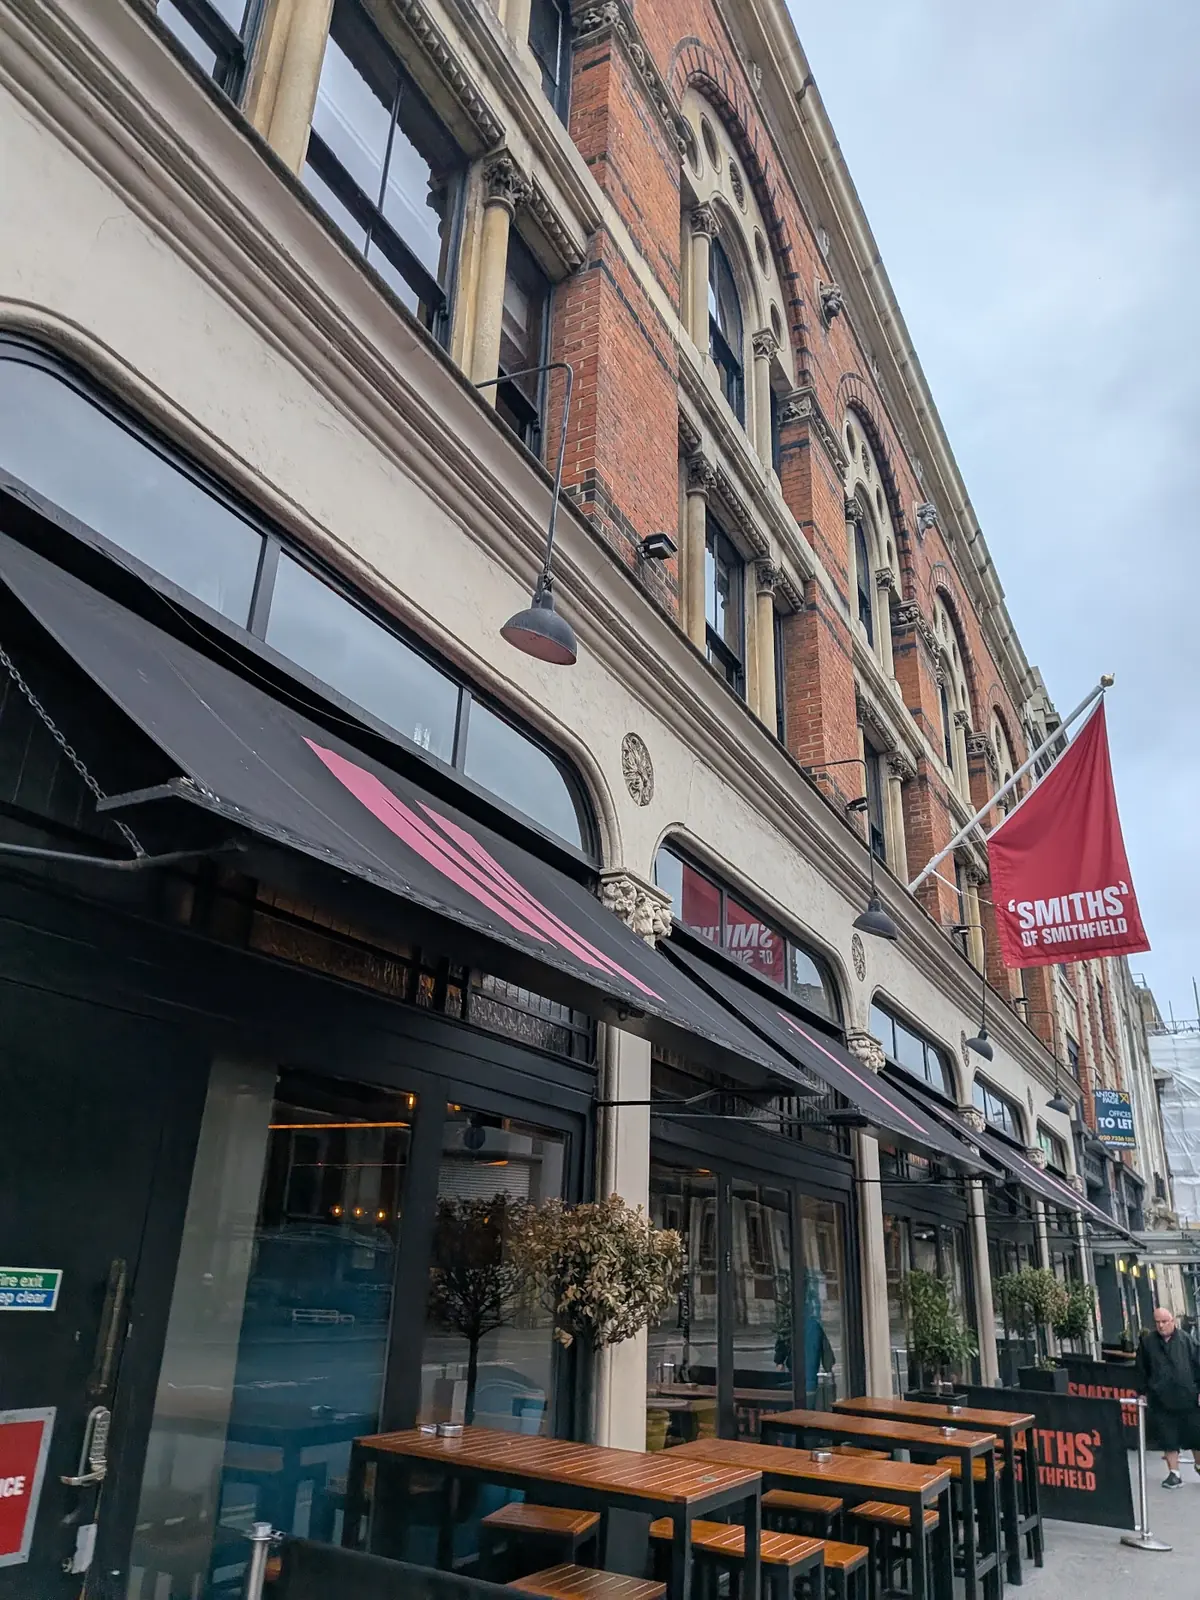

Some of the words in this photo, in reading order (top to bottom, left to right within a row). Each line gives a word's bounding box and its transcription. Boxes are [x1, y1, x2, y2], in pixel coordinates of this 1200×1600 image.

[1008, 881, 1128, 929] 'SMITHS'
[1022, 930, 1038, 947] OF
[1043, 918, 1128, 944] SMITHFIELD
[1109, 1110, 1131, 1118] OFFICES
[1098, 1117, 1115, 1129] TO
[1118, 1118, 1132, 1130] LET
[20, 1274, 44, 1287] exit
[16, 1291, 47, 1303] clear
[1015, 1463, 1096, 1491] THFIELD
